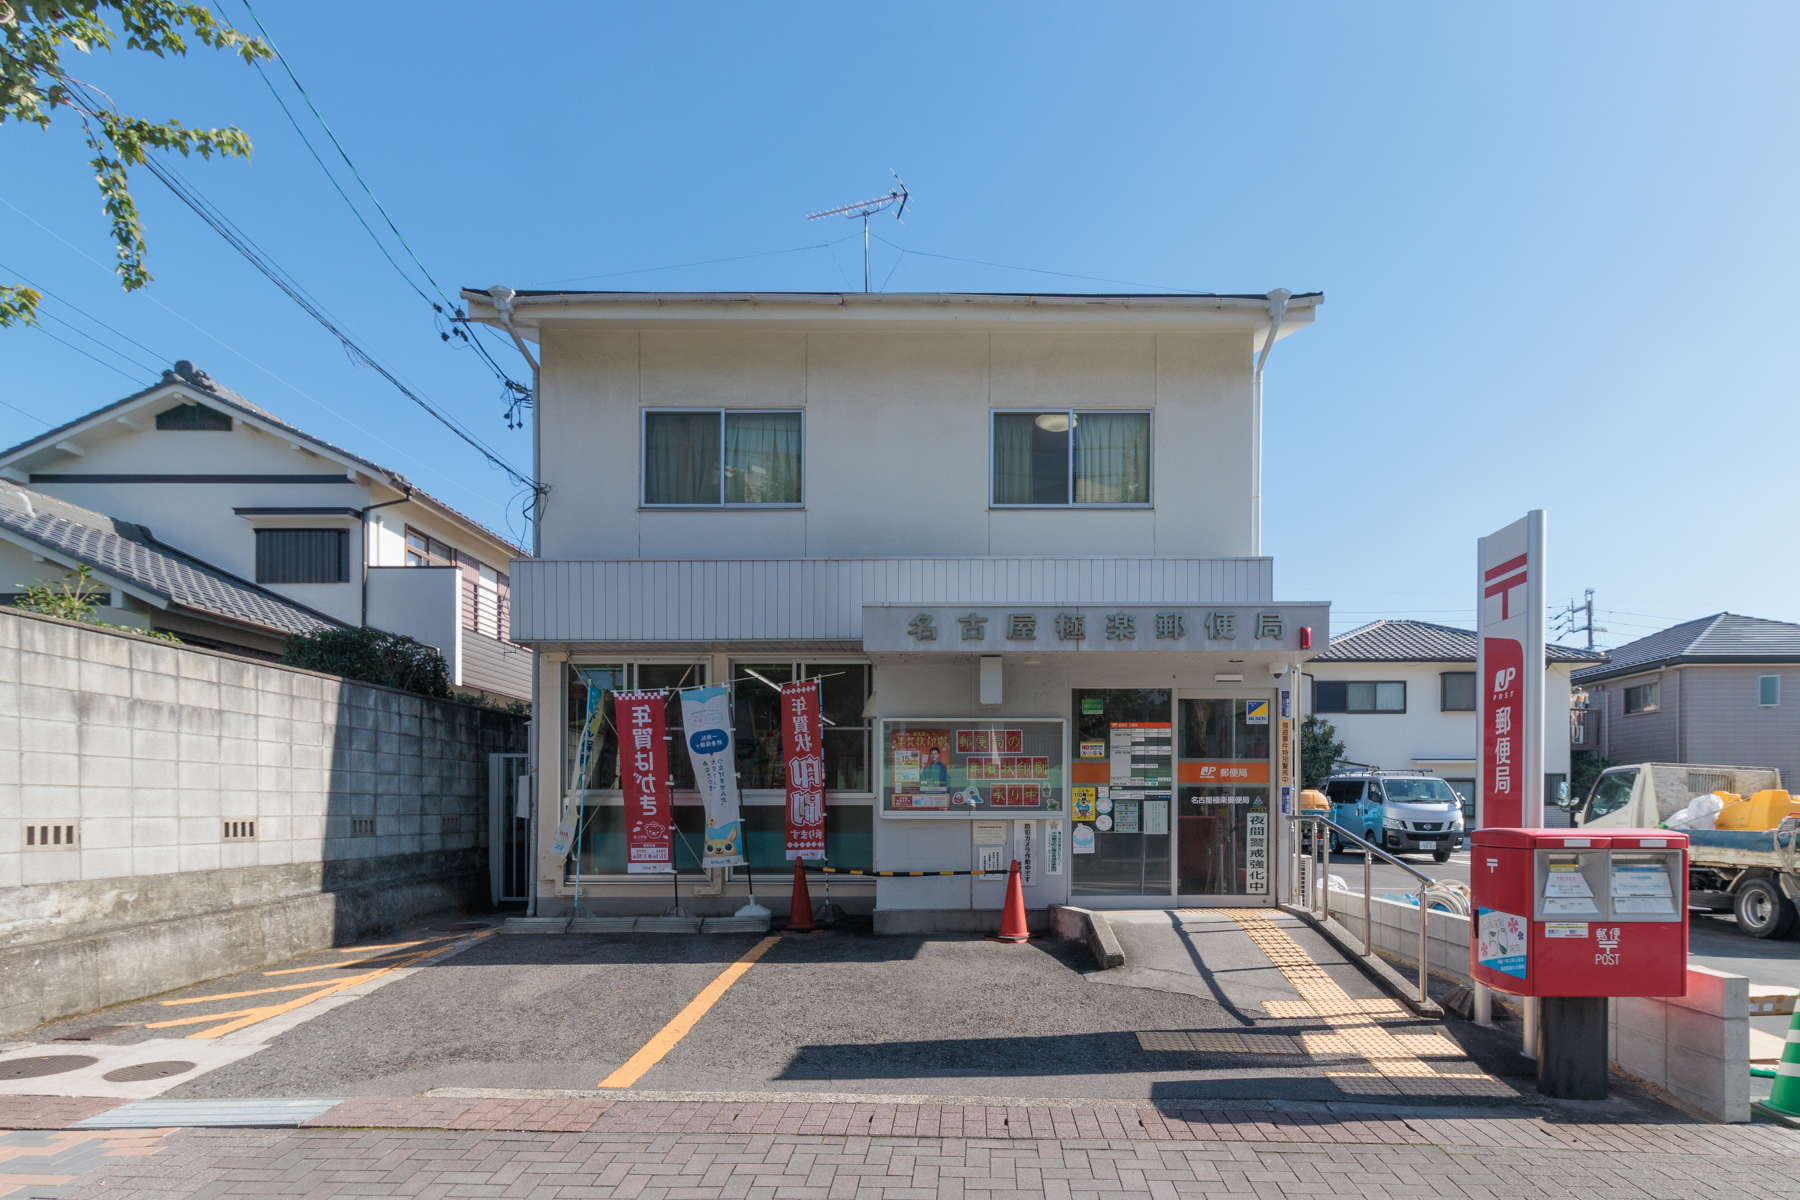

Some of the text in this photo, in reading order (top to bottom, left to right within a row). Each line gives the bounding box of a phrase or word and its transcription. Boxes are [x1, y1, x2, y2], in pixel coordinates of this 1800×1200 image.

[907, 612, 1287, 642] 名古屋極楽郵便局
[1493, 691, 1514, 701] POST
[896, 736, 948, 747] 年賀状印刷
[958, 735, 1021, 749] 郵便局の
[1281, 721, 1289, 783] 強盗事件特別警戒中
[1494, 706, 1511, 794] 郵便局
[969, 761, 1047, 776] 年賀状印刷
[1220, 768, 1248, 777] 郵便局
[992, 788, 1038, 802] 承り中
[1191, 796, 1250, 804] 名古屋極楽郵便局
[1249, 815, 1265, 892] 夜間警戒強化中
[1595, 928, 1621, 942] 郵便
[1595, 953, 1620, 966] POST
